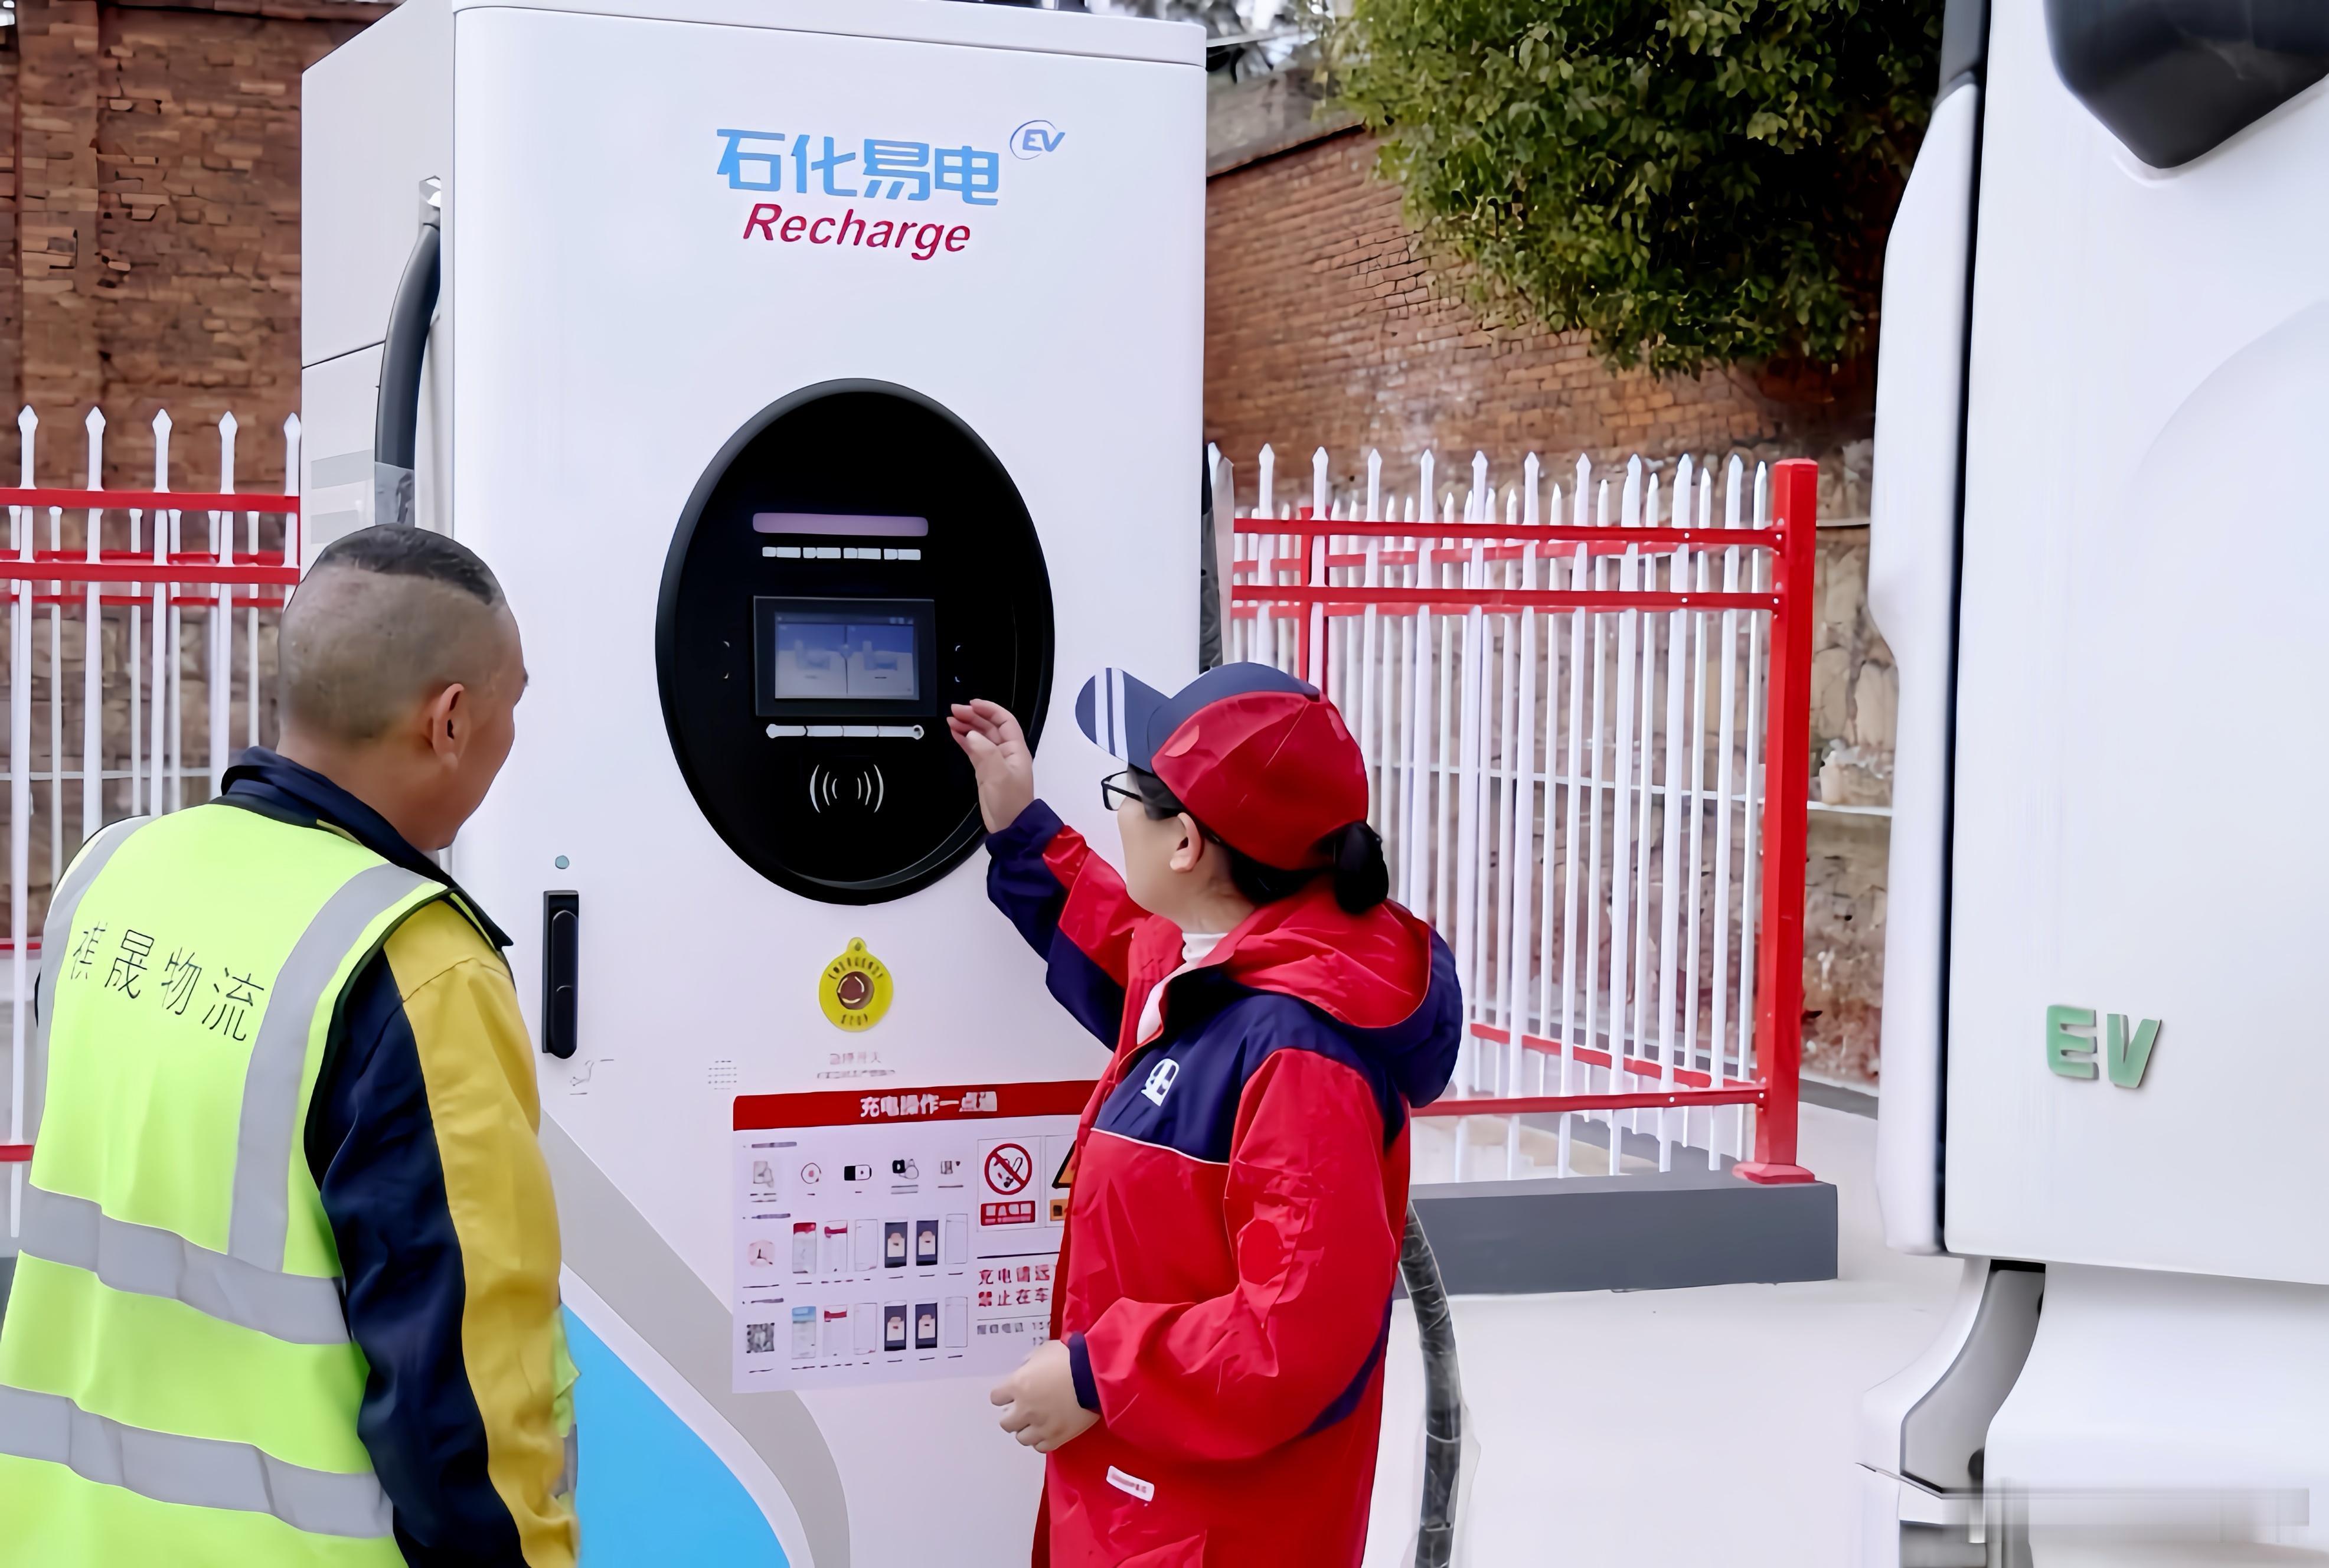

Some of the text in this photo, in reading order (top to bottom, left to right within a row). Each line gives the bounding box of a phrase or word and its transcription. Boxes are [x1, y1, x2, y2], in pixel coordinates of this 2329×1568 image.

[716, 128, 999, 206] 石化易电
[1022, 129, 1066, 152] EV
[743, 202, 971, 260] Recharge
[2046, 1004, 2163, 1090] EV
